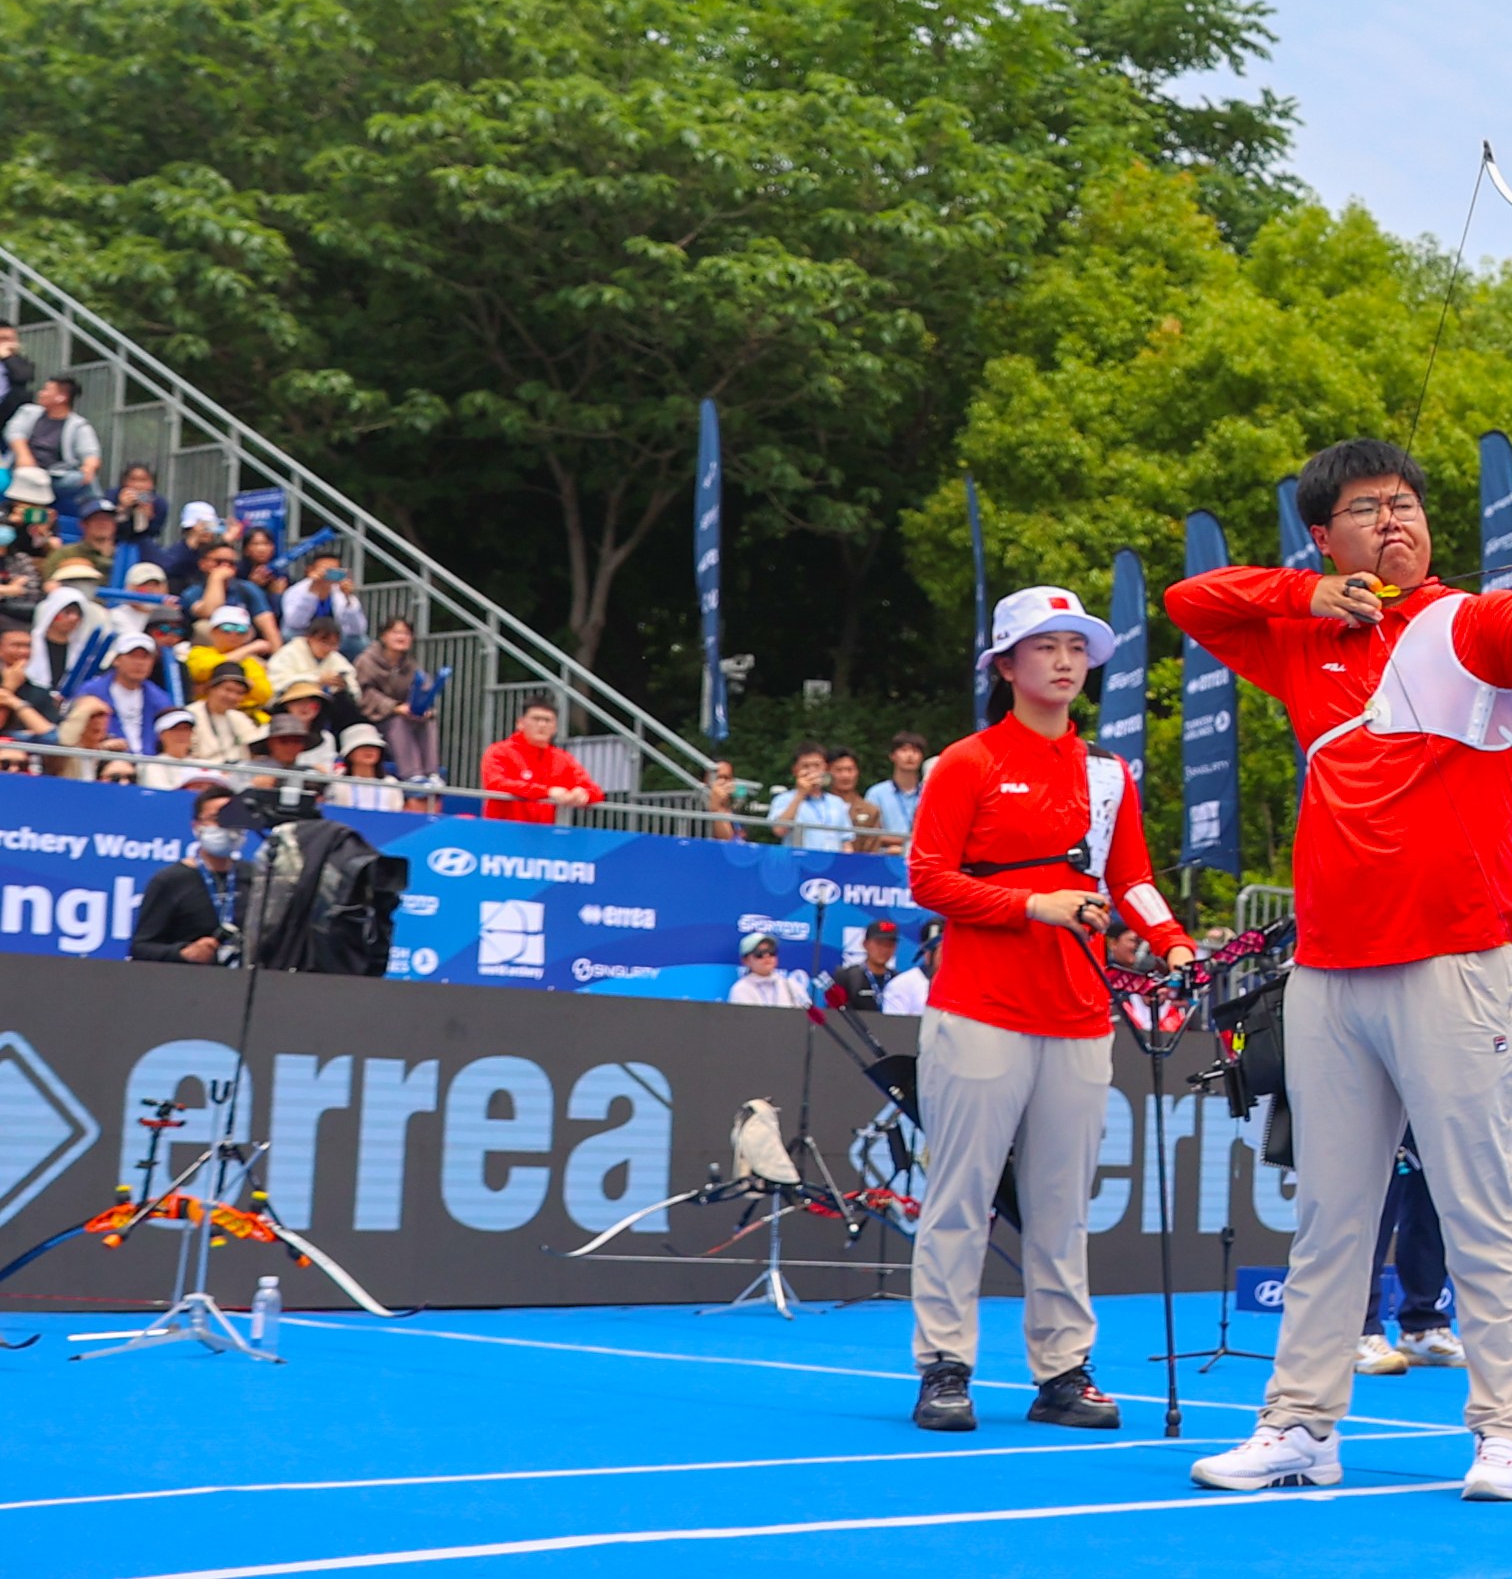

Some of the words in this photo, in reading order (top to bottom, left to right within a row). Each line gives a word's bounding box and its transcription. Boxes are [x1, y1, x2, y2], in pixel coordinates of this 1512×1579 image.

[95, 834, 181, 861] World
[481, 854, 595, 884] HYUNDAI
[604, 905, 656, 929] errea
[121, 1039, 672, 1233] errea
